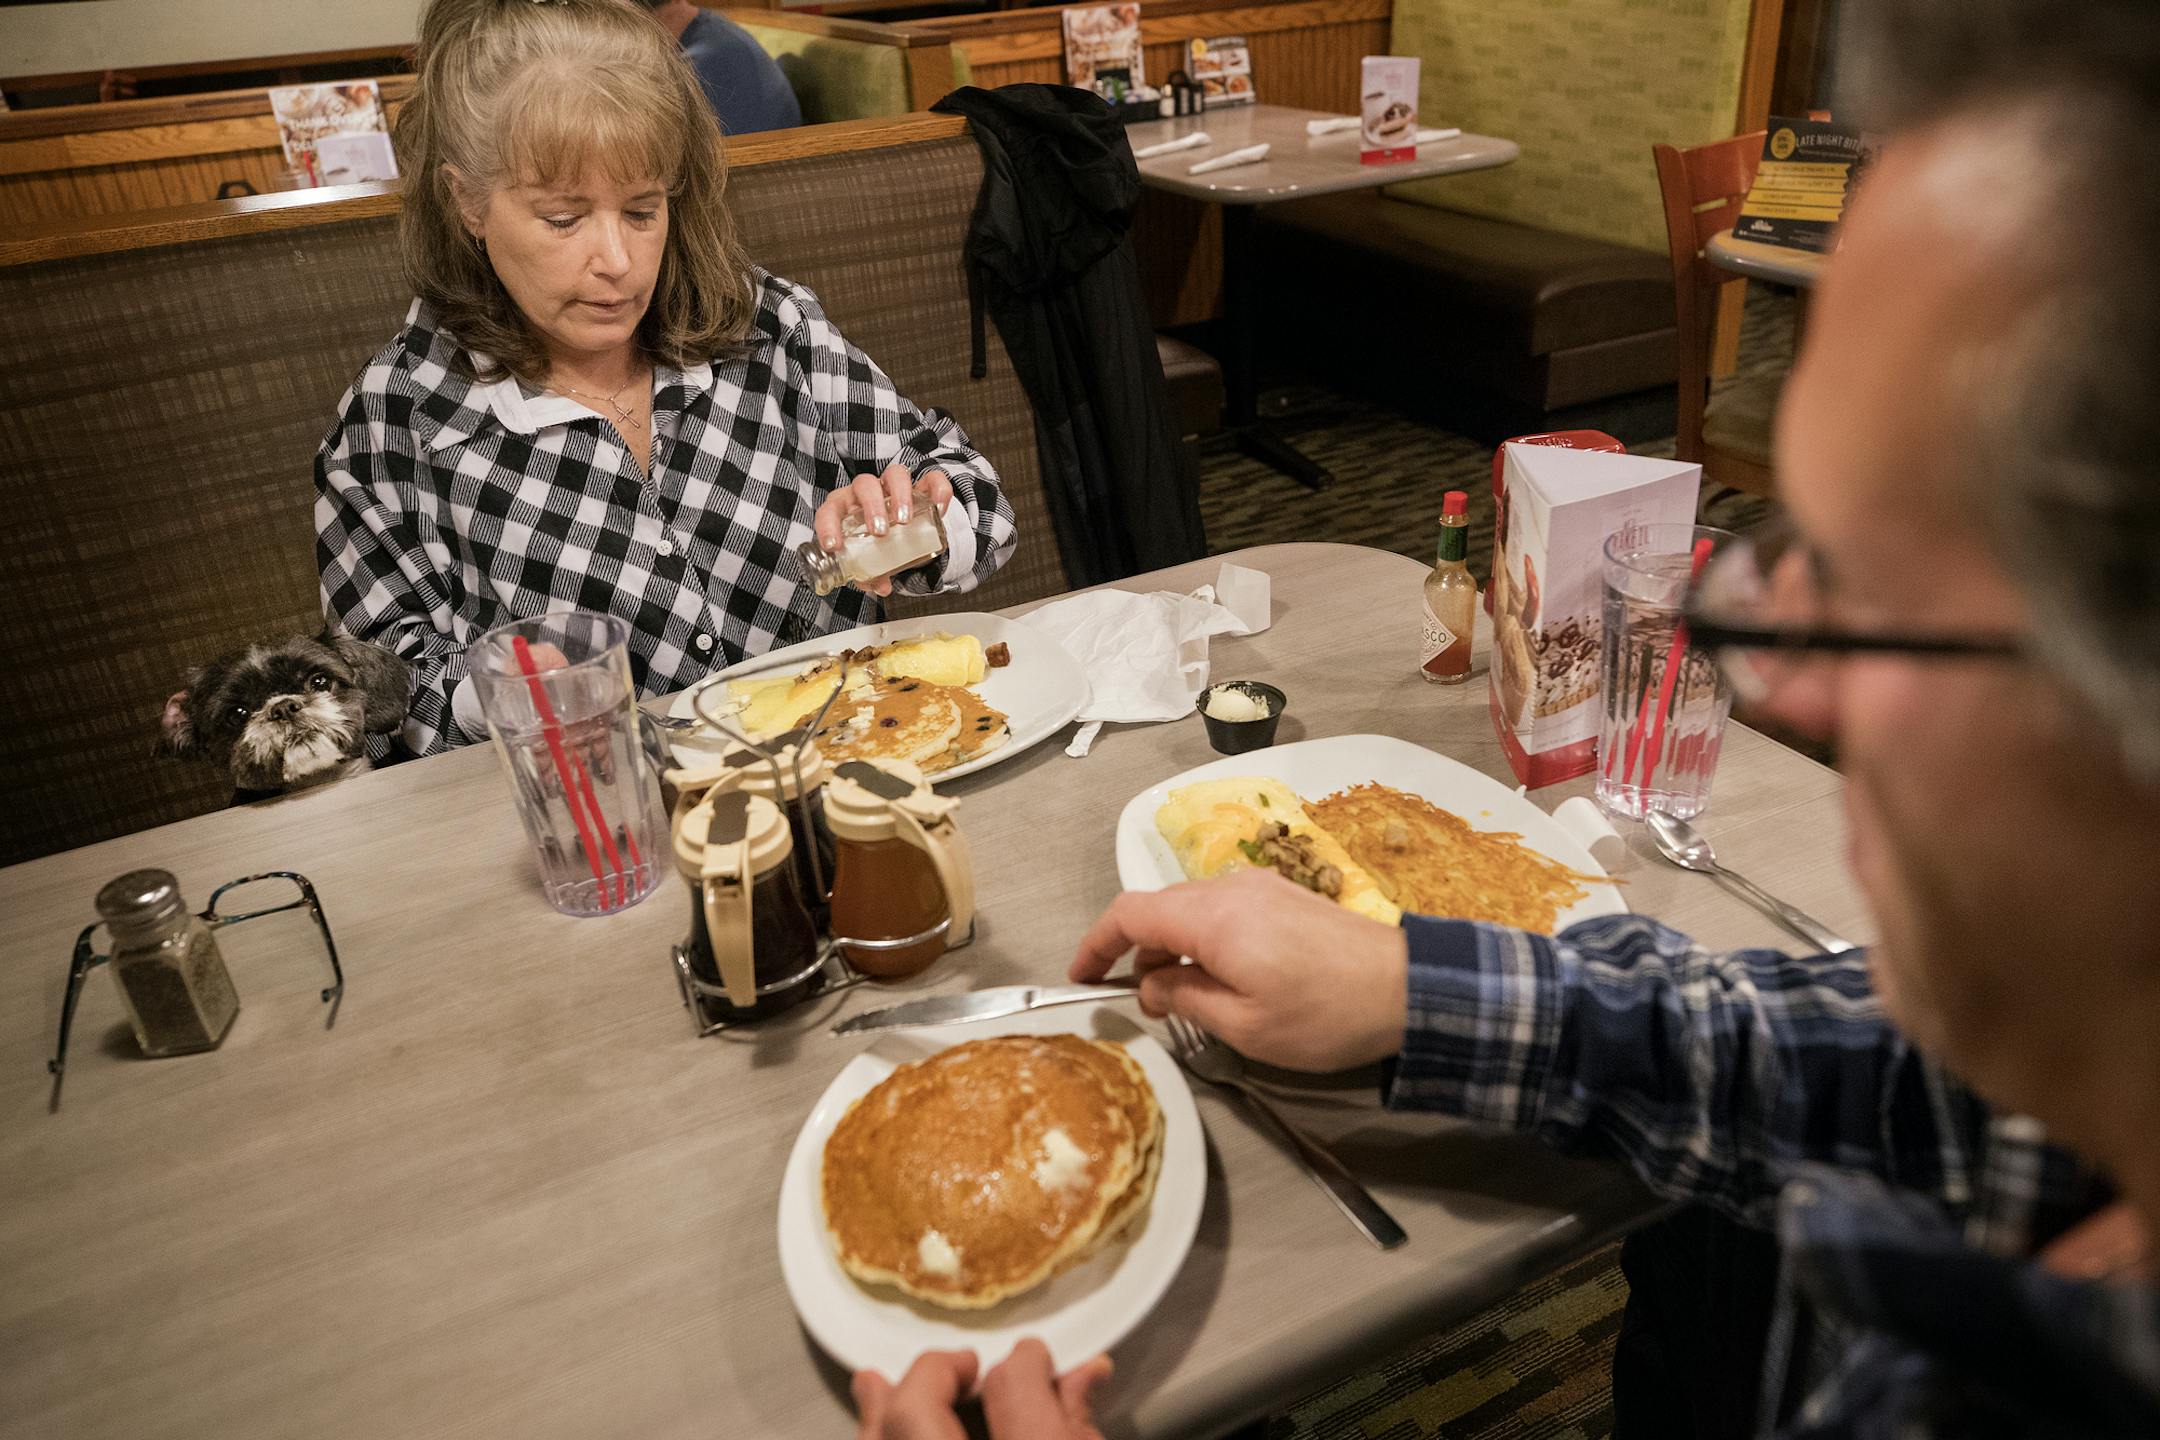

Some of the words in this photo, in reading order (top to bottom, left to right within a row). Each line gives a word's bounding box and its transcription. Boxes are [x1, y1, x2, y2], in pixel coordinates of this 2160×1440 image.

[1796, 134, 1816, 148] LATE
[1816, 134, 1843, 147] NIGHT
[1421, 628, 1447, 643] SCO
